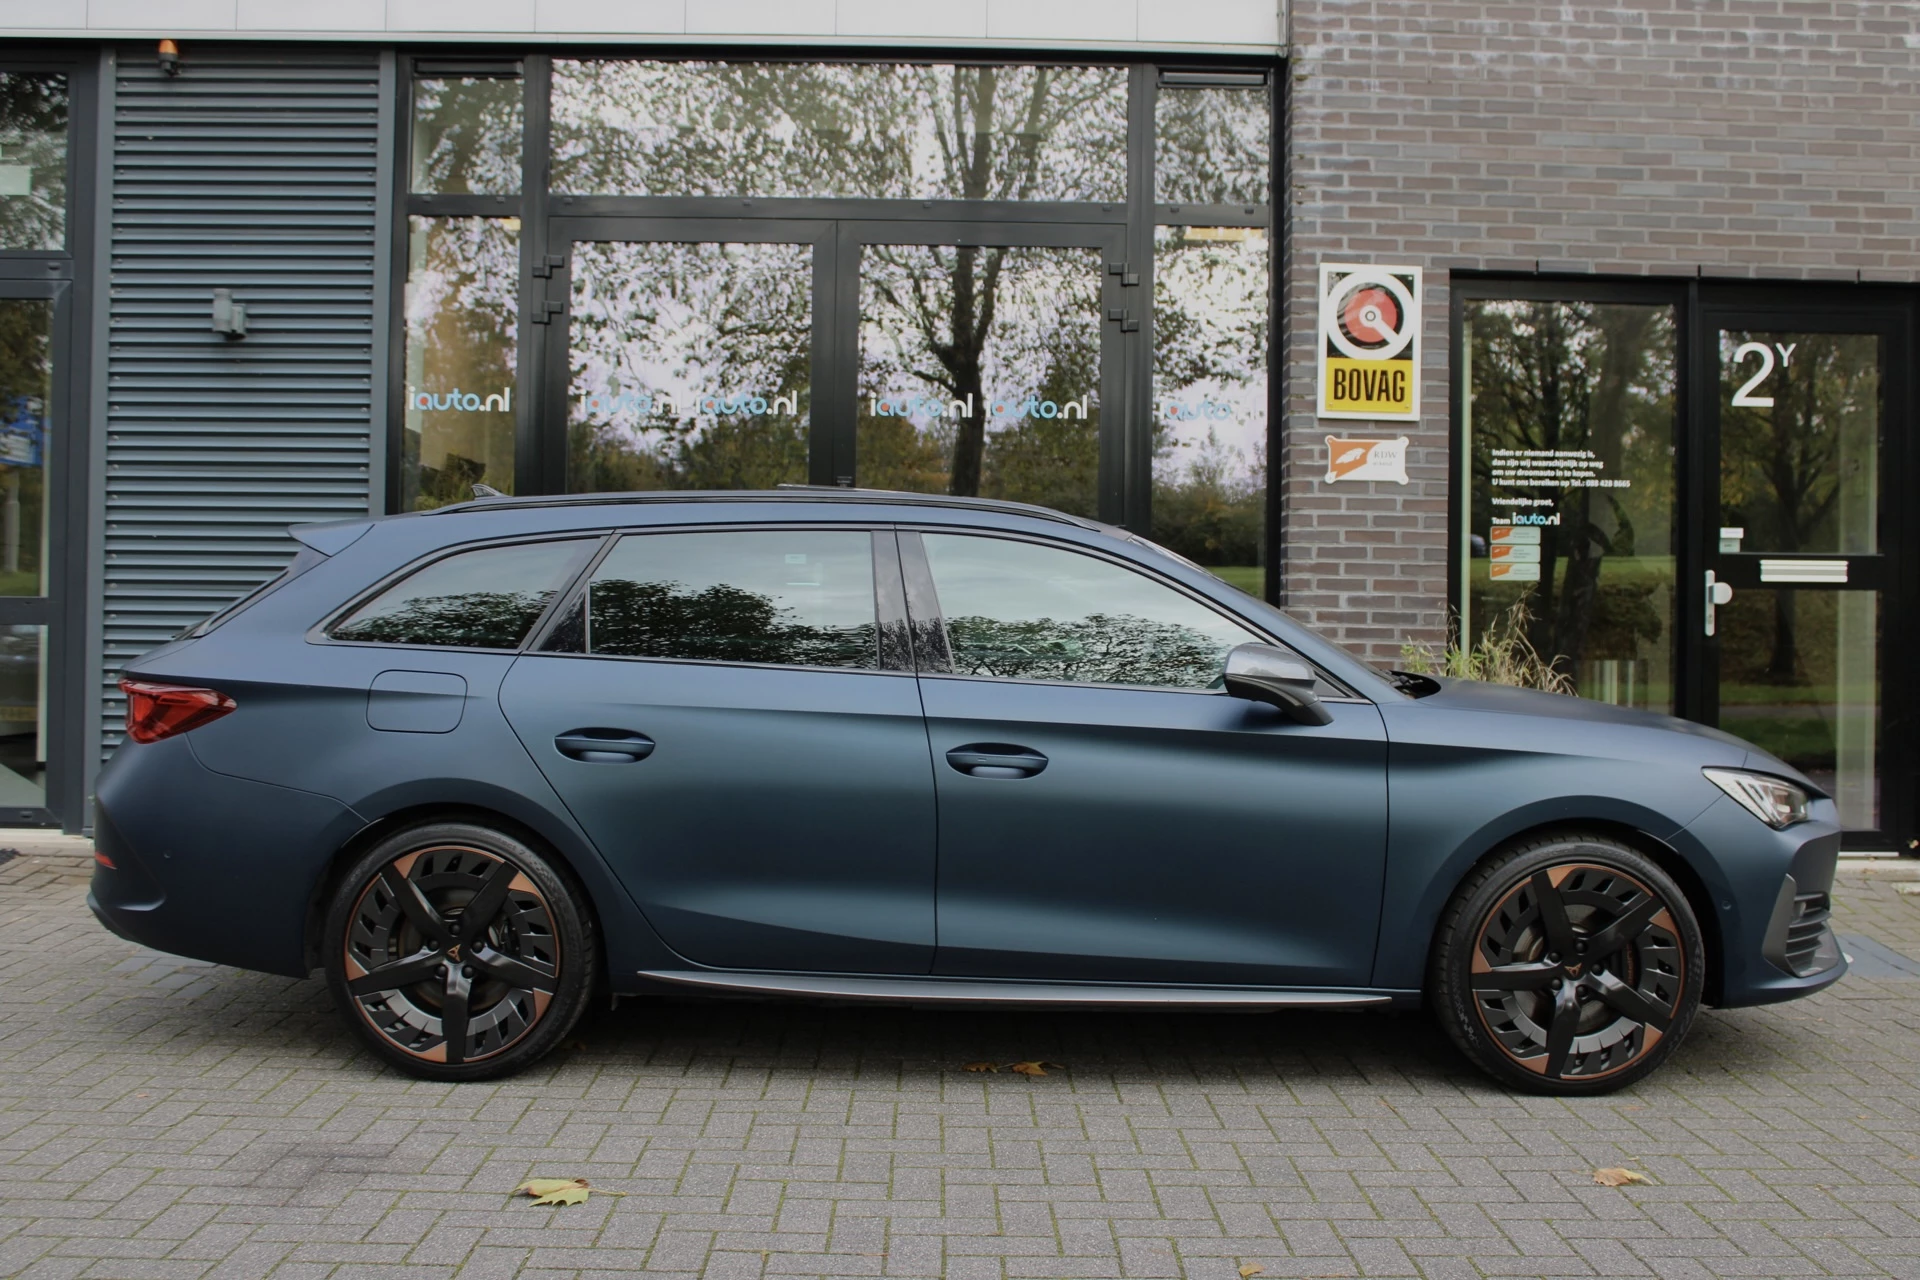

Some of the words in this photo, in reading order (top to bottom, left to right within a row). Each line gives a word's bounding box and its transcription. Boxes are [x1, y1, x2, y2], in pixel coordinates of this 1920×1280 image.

[1333, 368, 1406, 402] BOVAG
[408, 386, 511, 411] iauto.nl
[696, 389, 798, 415] iauto.nl
[870, 391, 973, 418] iauto.nl
[985, 394, 1088, 419] iauto.nl
[1492, 449, 1514, 457] Indien
[1524, 449, 1554, 457] niemand
[1555, 450, 1587, 459] aanwezig
[1506, 459, 1519, 468] zijn
[1520, 459, 1531, 468] wij
[1532, 459, 1578, 469] waarschijnlijk
[1579, 461, 1588, 469] op
[1589, 461, 1604, 469] weg
[1517, 469, 1555, 477] droomauto
[1572, 470, 1596, 478] kopen.
[1492, 478, 1498, 486] U
[1499, 478, 1515, 486] kunt
[1530, 479, 1559, 487] bereiken
[1492, 498, 1532, 507] Vriendelijke
[1533, 499, 1554, 507] groet,
[1492, 517, 1511, 525] Team
[1512, 512, 1560, 525] iauto.nl
